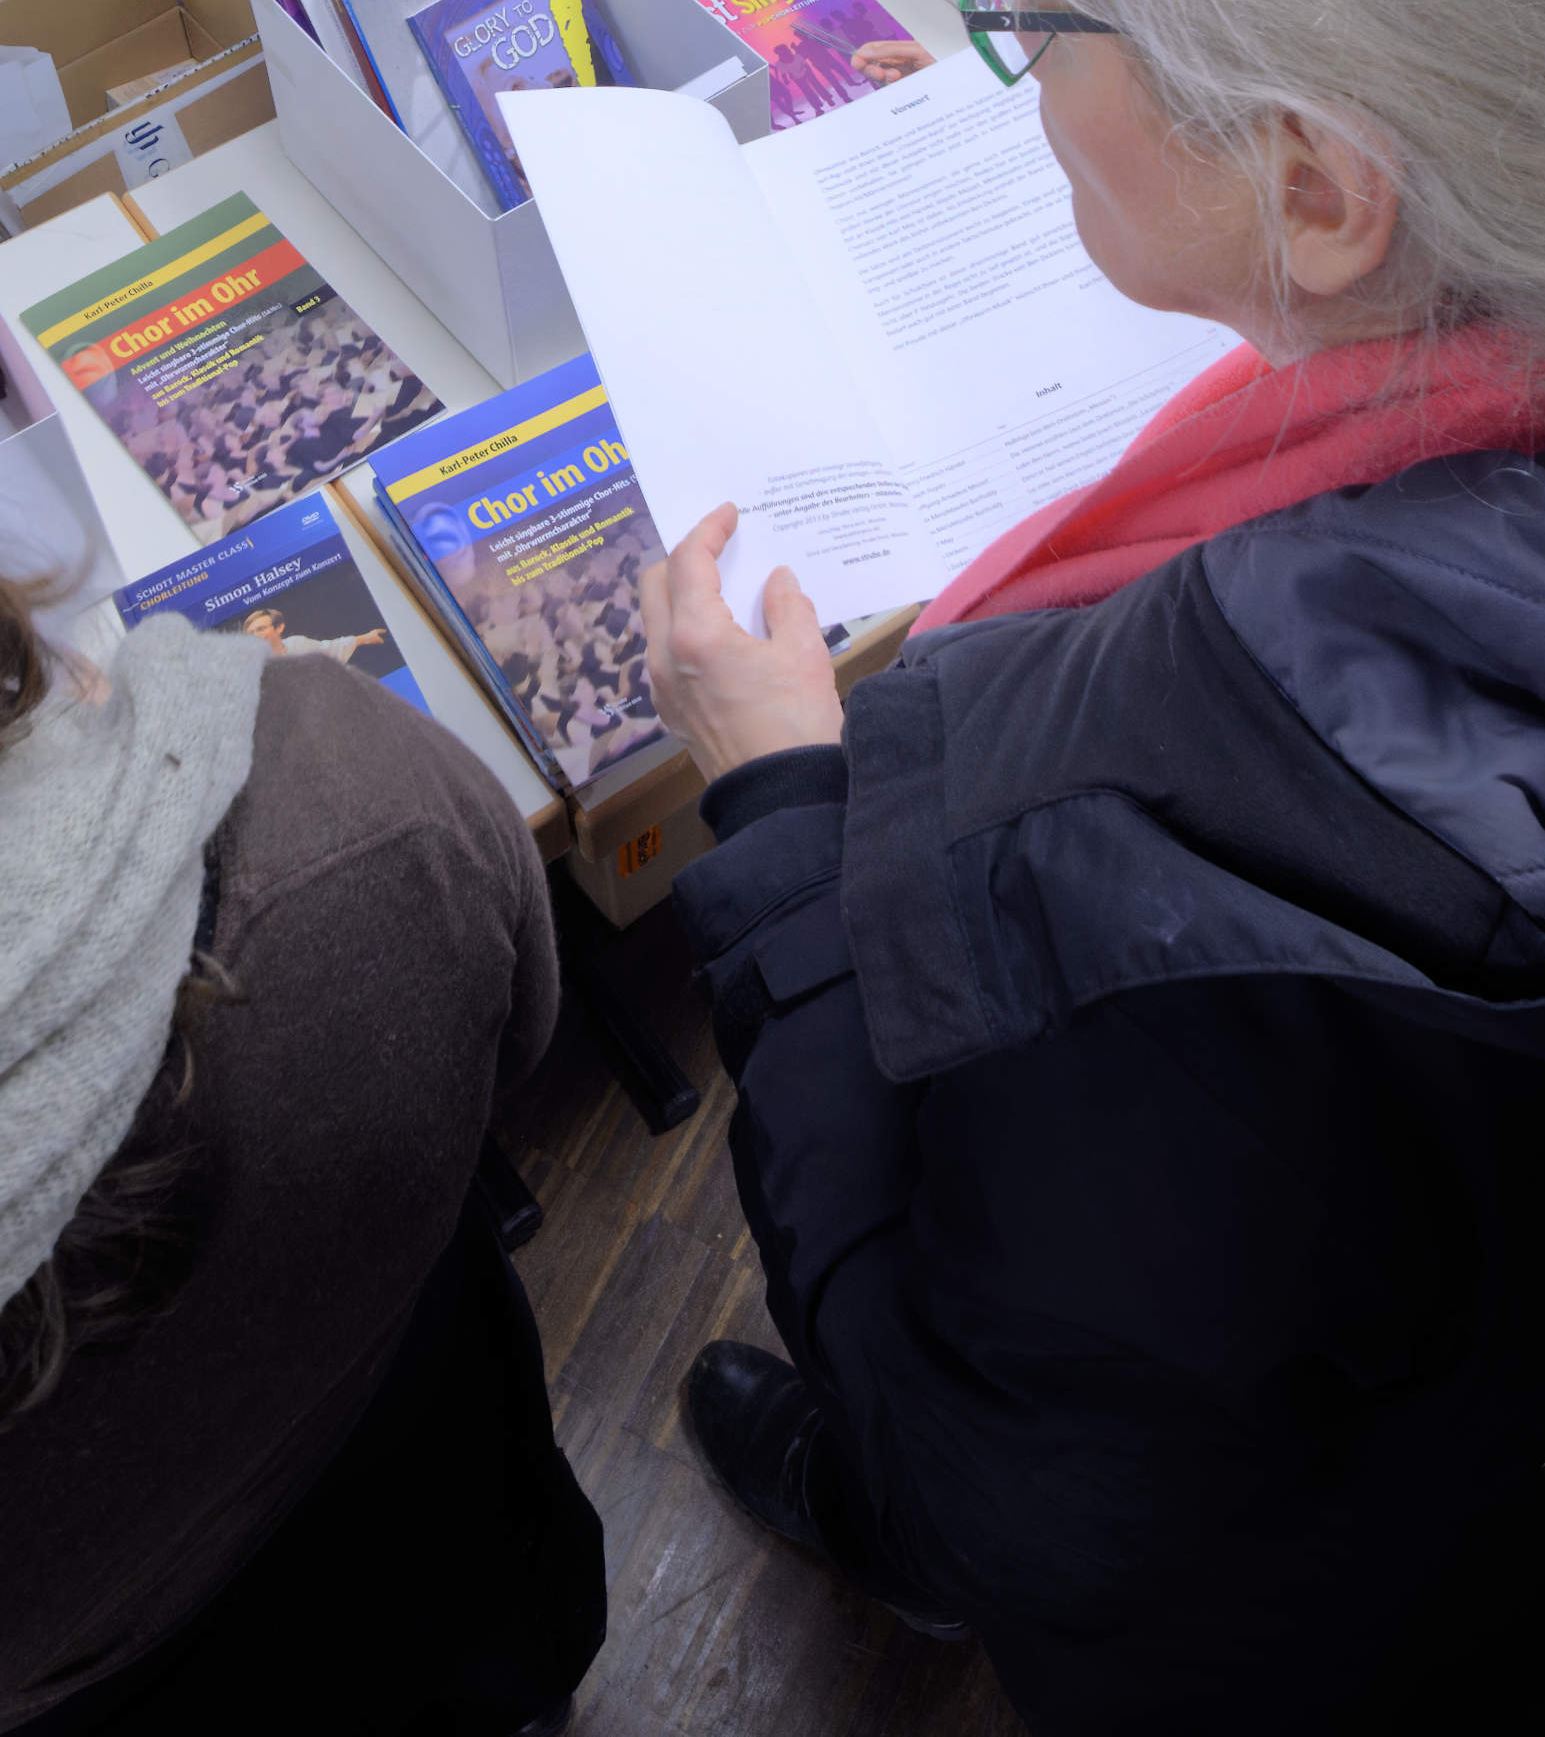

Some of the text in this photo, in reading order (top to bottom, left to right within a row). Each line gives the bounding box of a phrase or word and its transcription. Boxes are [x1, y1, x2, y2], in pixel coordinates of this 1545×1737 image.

[454, 0, 533, 57] GLORY TO
[492, 14, 555, 70] GOD
[890, 93, 930, 116] Vorwort
[83, 279, 153, 321] Karl-Peter Chilla
[110, 268, 262, 358] Chor im Ohr
[296, 299, 315, 313] Band
[130, 319, 226, 374] Advent und Weihnachten
[137, 368, 160, 384] Leicht
[160, 352, 191, 372] singbare
[190, 331, 230, 355] 3-stimmige
[229, 313, 261, 334] Chor-Hits
[152, 334, 263, 399] aus Barock, Klassik und Romantik
[144, 380, 157, 391] mit
[157, 359, 239, 407] bis zum Traditional-Pop
[1035, 380, 1063, 399] Inhalt
[440, 434, 518, 476] Karl-Peter Chilla
[468, 439, 630, 530] Chor im Oh
[490, 478, 629, 553] Leicht singbare 3-stimmige Chor-Hits
[505, 506, 633, 576] aus Barock, Klassik und Romantik
[136, 542, 248, 601] SCHOTT MASTER CLASS
[243, 553, 342, 606] Vom Konzept zum Konzert
[497, 551, 512, 563] mit
[512, 535, 605, 586] bis zum Traditional-Pop
[140, 571, 209, 611] CHORLEITUNG
[205, 557, 302, 613] Simon Halsey
